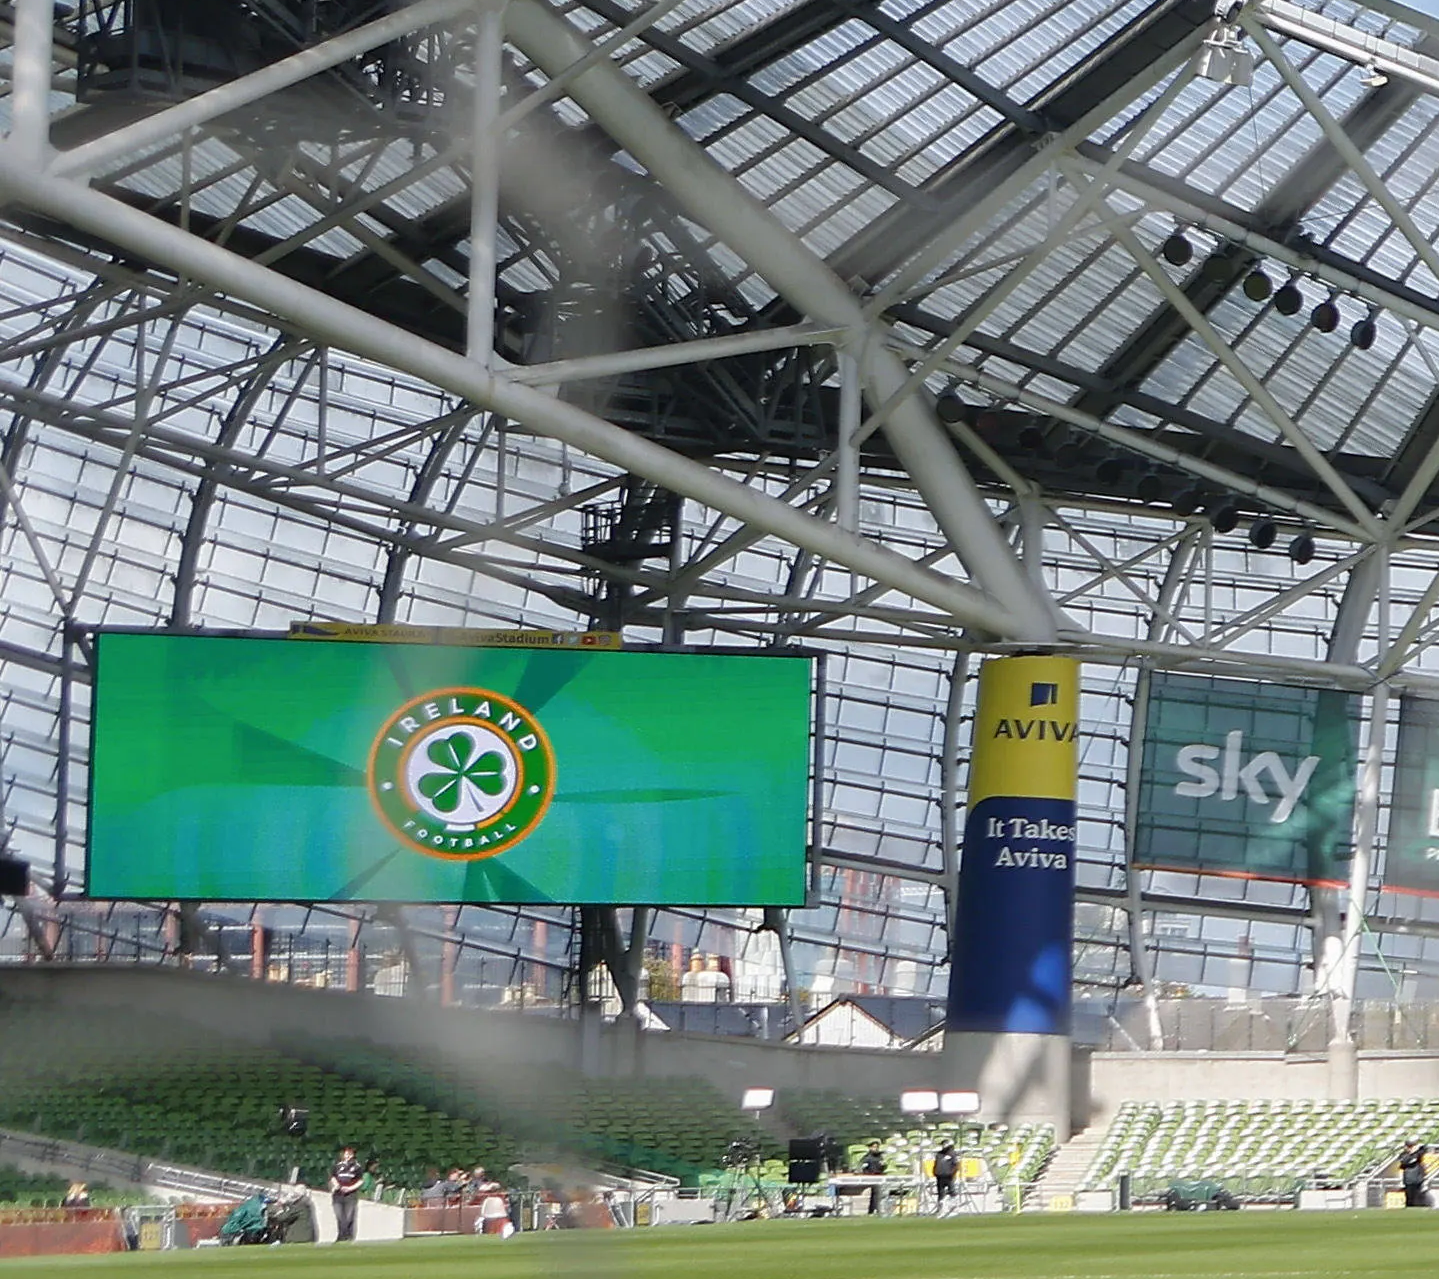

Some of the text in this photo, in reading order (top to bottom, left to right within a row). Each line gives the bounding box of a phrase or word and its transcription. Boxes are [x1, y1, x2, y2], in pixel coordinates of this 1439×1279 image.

[387, 698, 538, 751] IRELAND
[1175, 730, 1321, 823] sky
[403, 820, 516, 848] FOOTBALL
[987, 817, 1075, 841] It Takes
[995, 847, 1068, 869] Aviva
